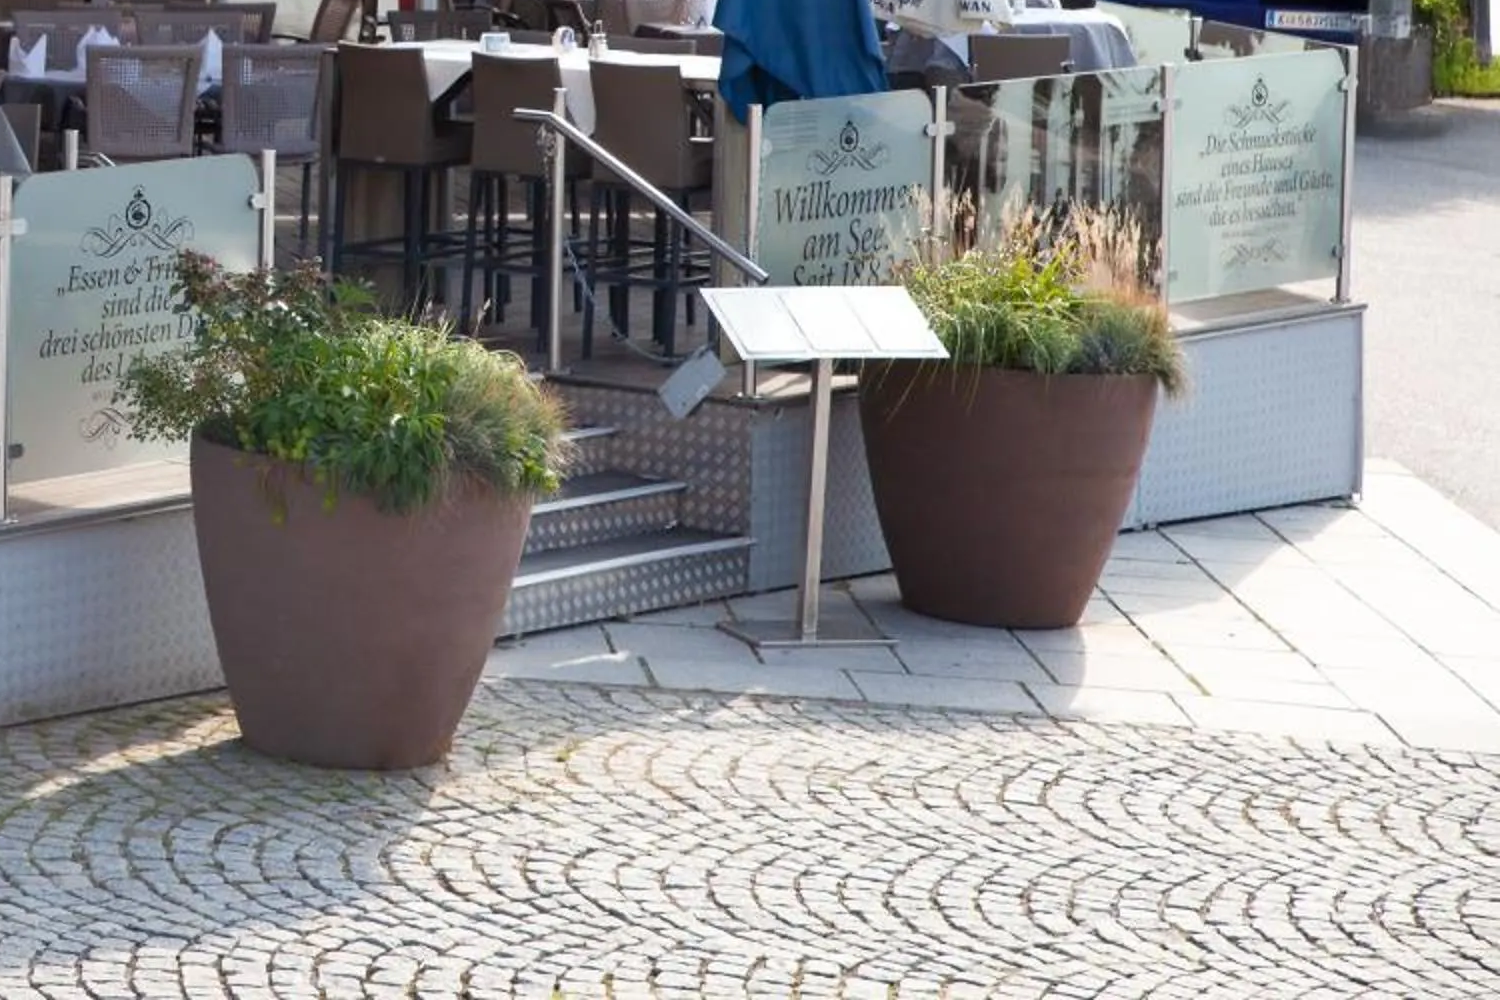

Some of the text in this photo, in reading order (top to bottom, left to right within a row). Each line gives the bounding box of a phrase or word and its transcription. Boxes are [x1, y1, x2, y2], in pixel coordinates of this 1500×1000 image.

[803, 218, 889, 261] am See.
[123, 258, 143, 286] &
[101, 284, 171, 319] sind die
[39, 328, 78, 359] drei
[81, 321, 171, 354] schönsten
[81, 355, 112, 385] des
